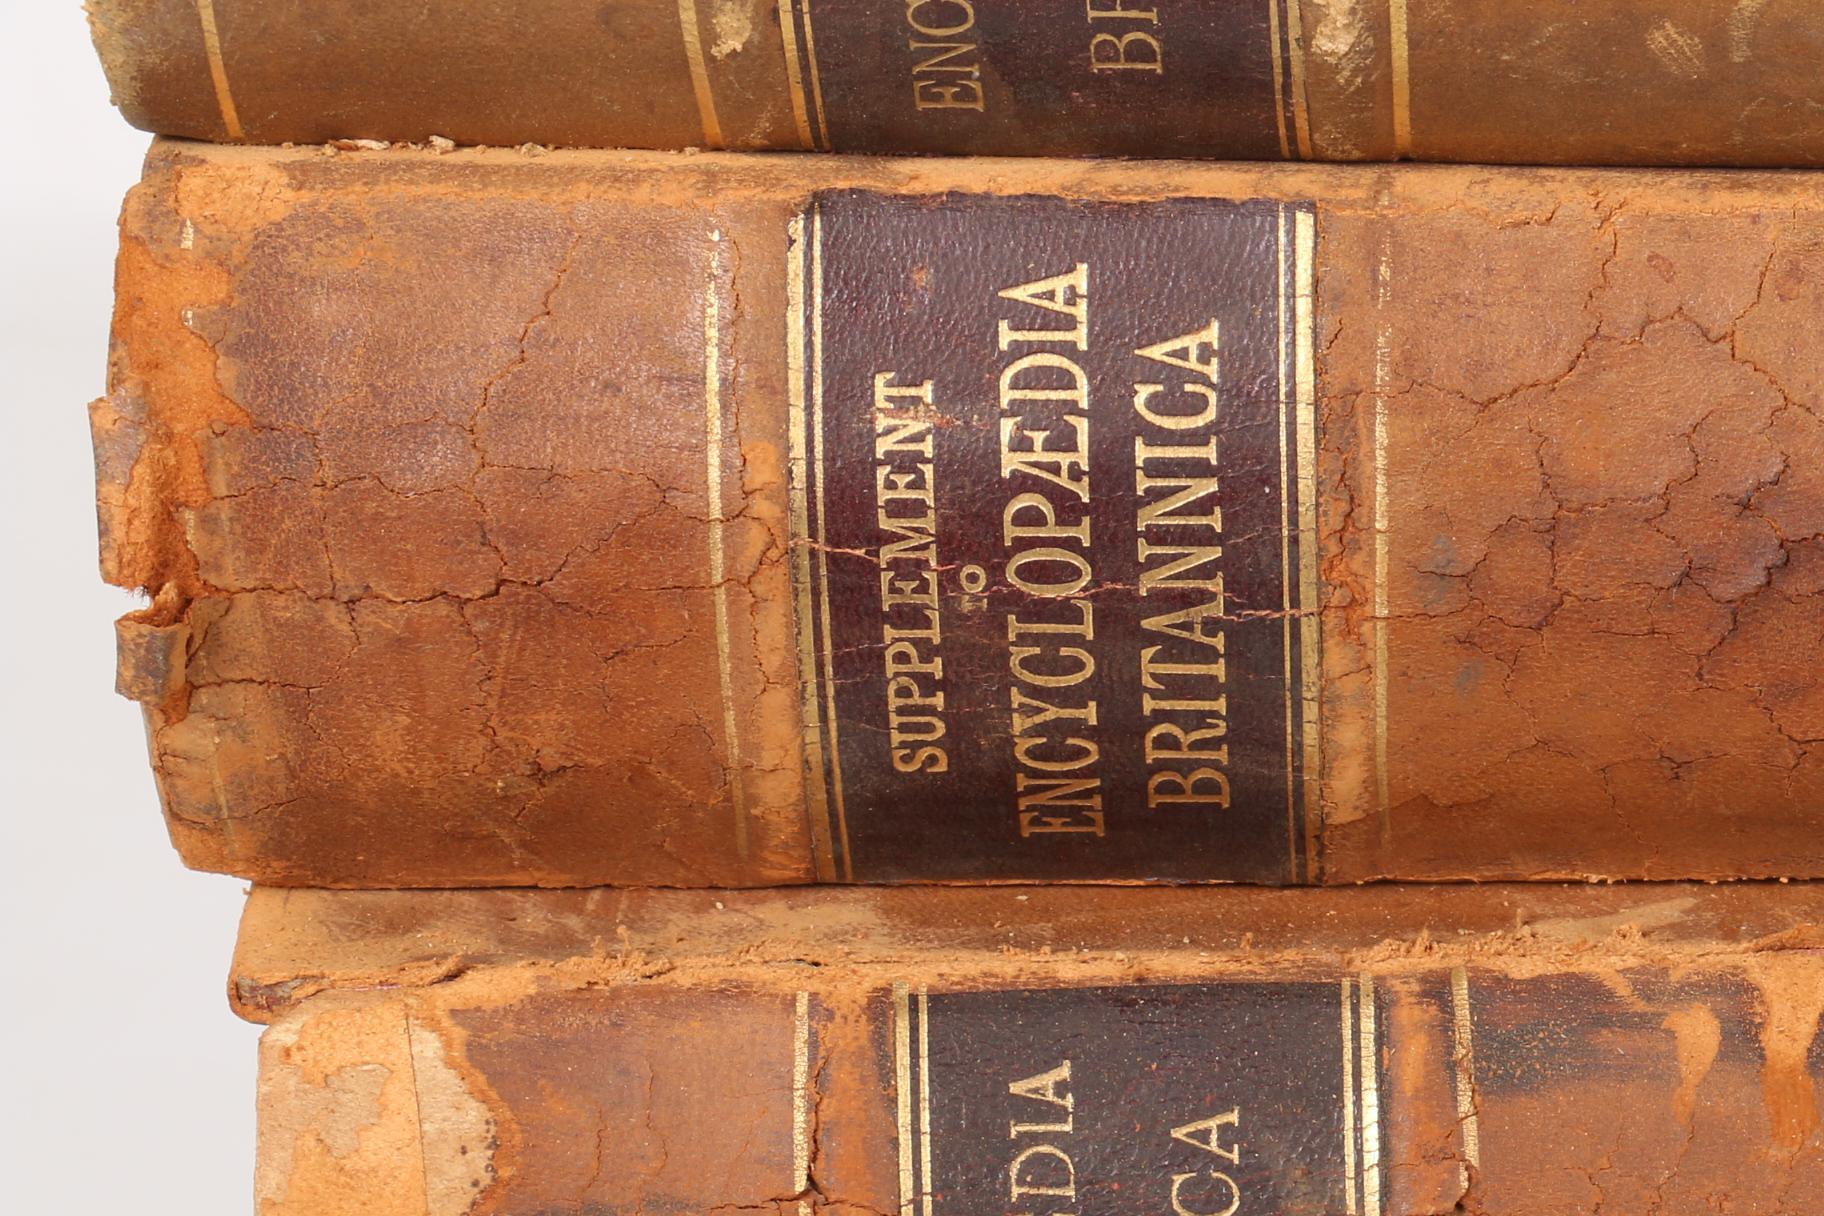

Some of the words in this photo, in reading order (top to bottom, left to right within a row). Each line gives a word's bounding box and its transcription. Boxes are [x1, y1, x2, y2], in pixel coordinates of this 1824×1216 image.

[874, 371, 948, 774] SUPPLEMENT
[998, 263, 1105, 838] ENCYCLOPÆDIA
[1133, 318, 1231, 809] BRITANNICA
